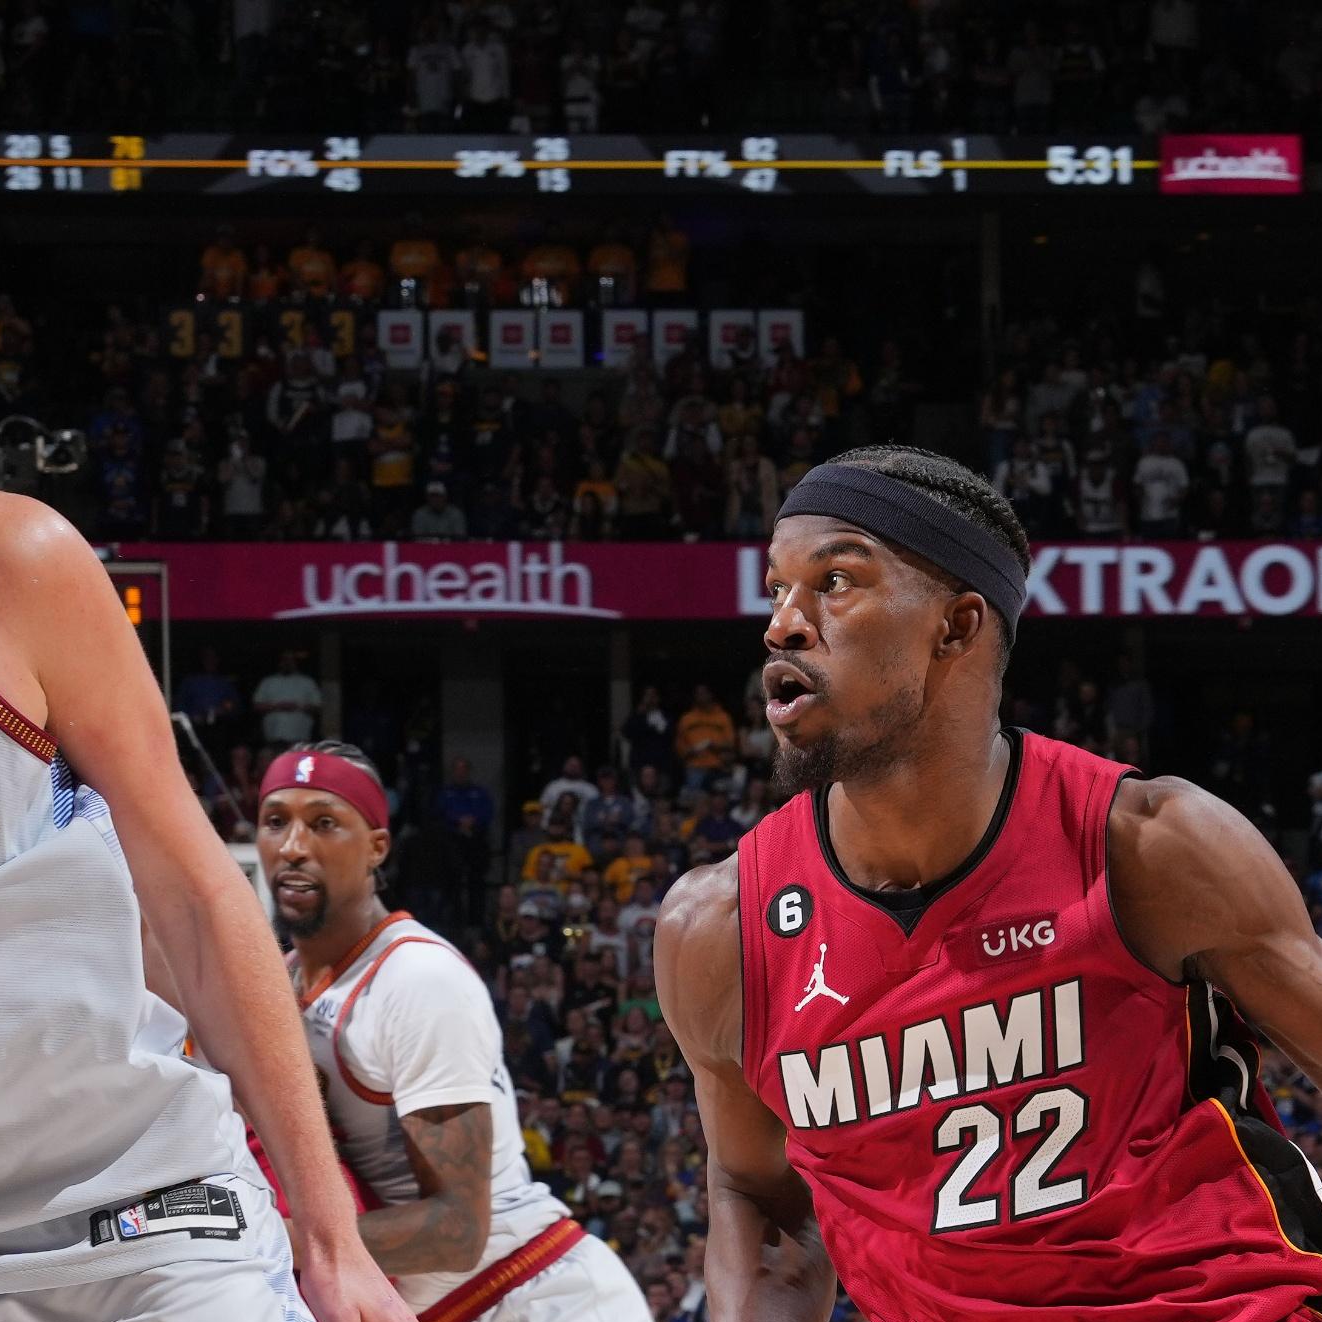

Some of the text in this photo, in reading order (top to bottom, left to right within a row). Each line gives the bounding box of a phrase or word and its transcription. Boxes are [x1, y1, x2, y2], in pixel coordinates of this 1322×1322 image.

[52, 167, 83, 191] 11
[664, 149, 732, 178] FT%
[883, 149, 943, 178] FLS
[1045, 145, 1133, 185] 5:31
[302, 541, 594, 610] uchealth
[778, 890, 804, 933] 6
[779, 977, 1085, 1131] MIAMI
[930, 1086, 1090, 1235] 22
